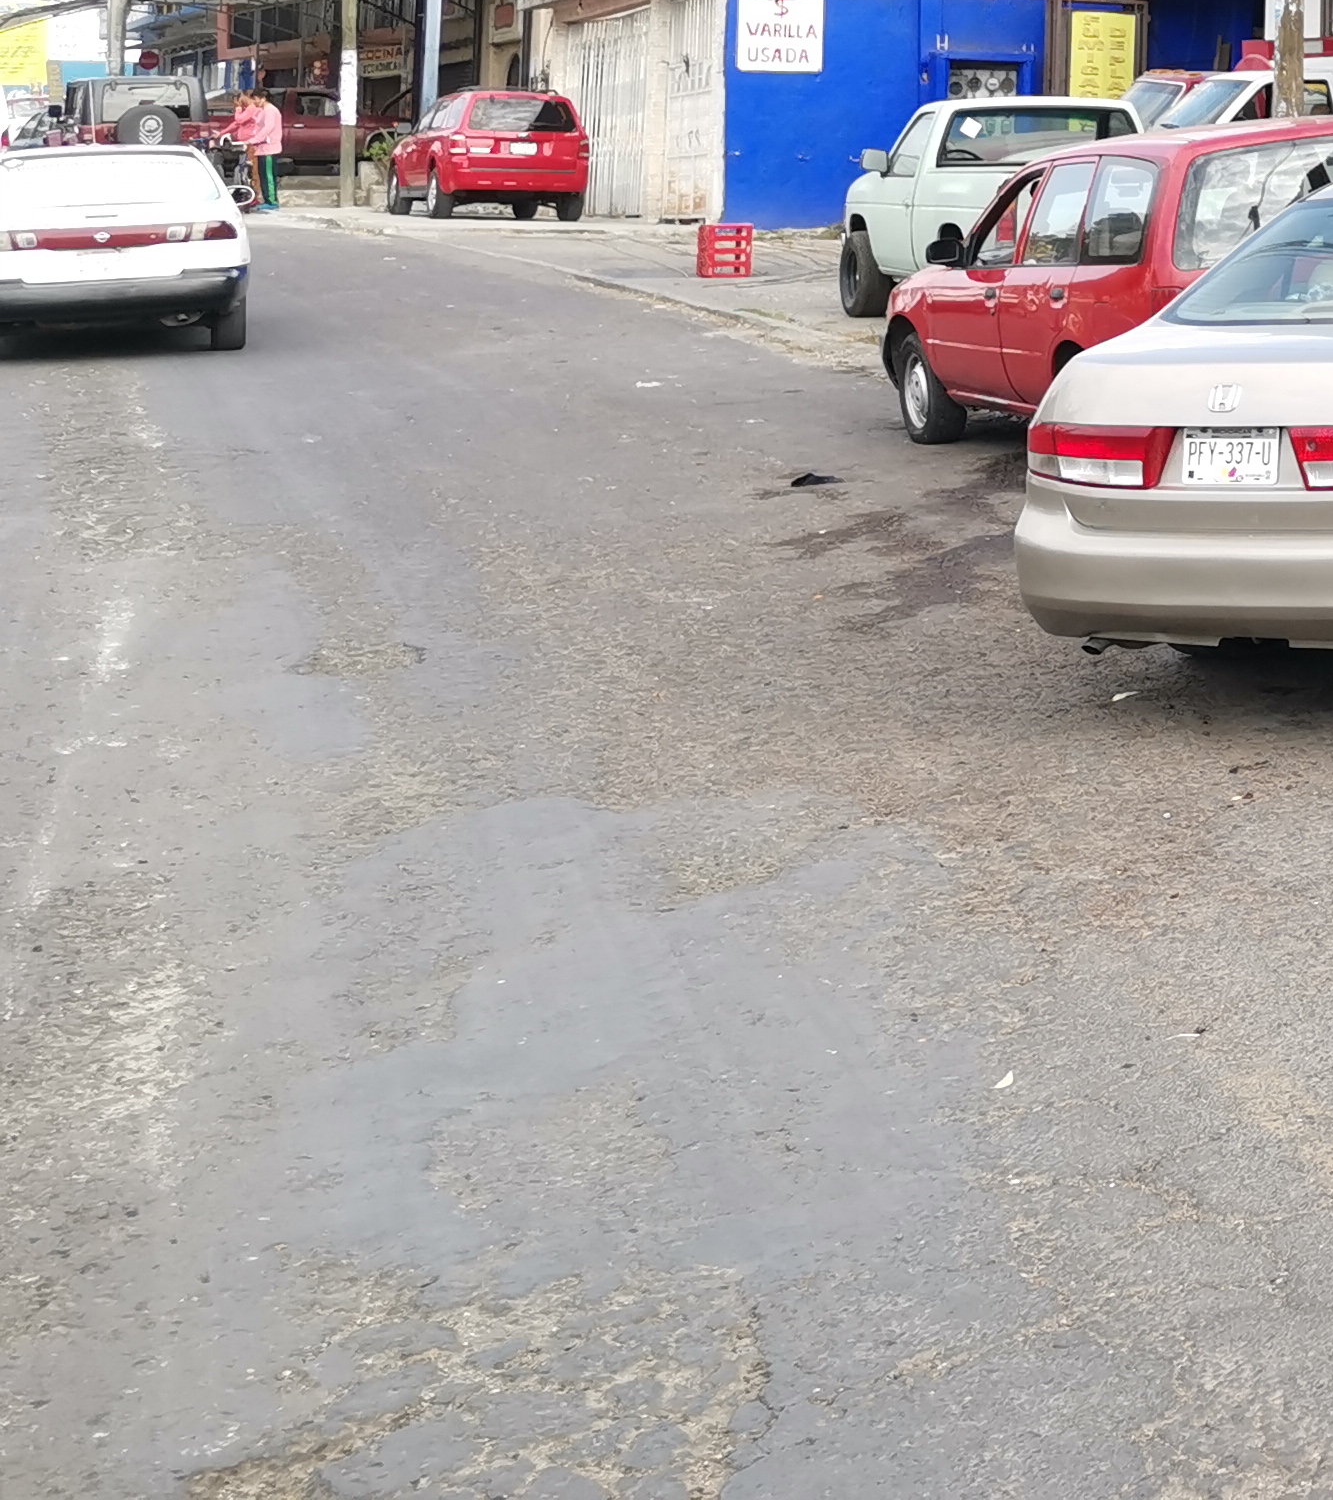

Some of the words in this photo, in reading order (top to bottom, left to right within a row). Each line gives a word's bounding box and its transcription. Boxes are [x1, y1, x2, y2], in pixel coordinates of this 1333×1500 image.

[746, 21, 818, 40] VARILLA
[747, 46, 810, 64] USADA
[1187, 441, 1272, 466] PFY-337-U
